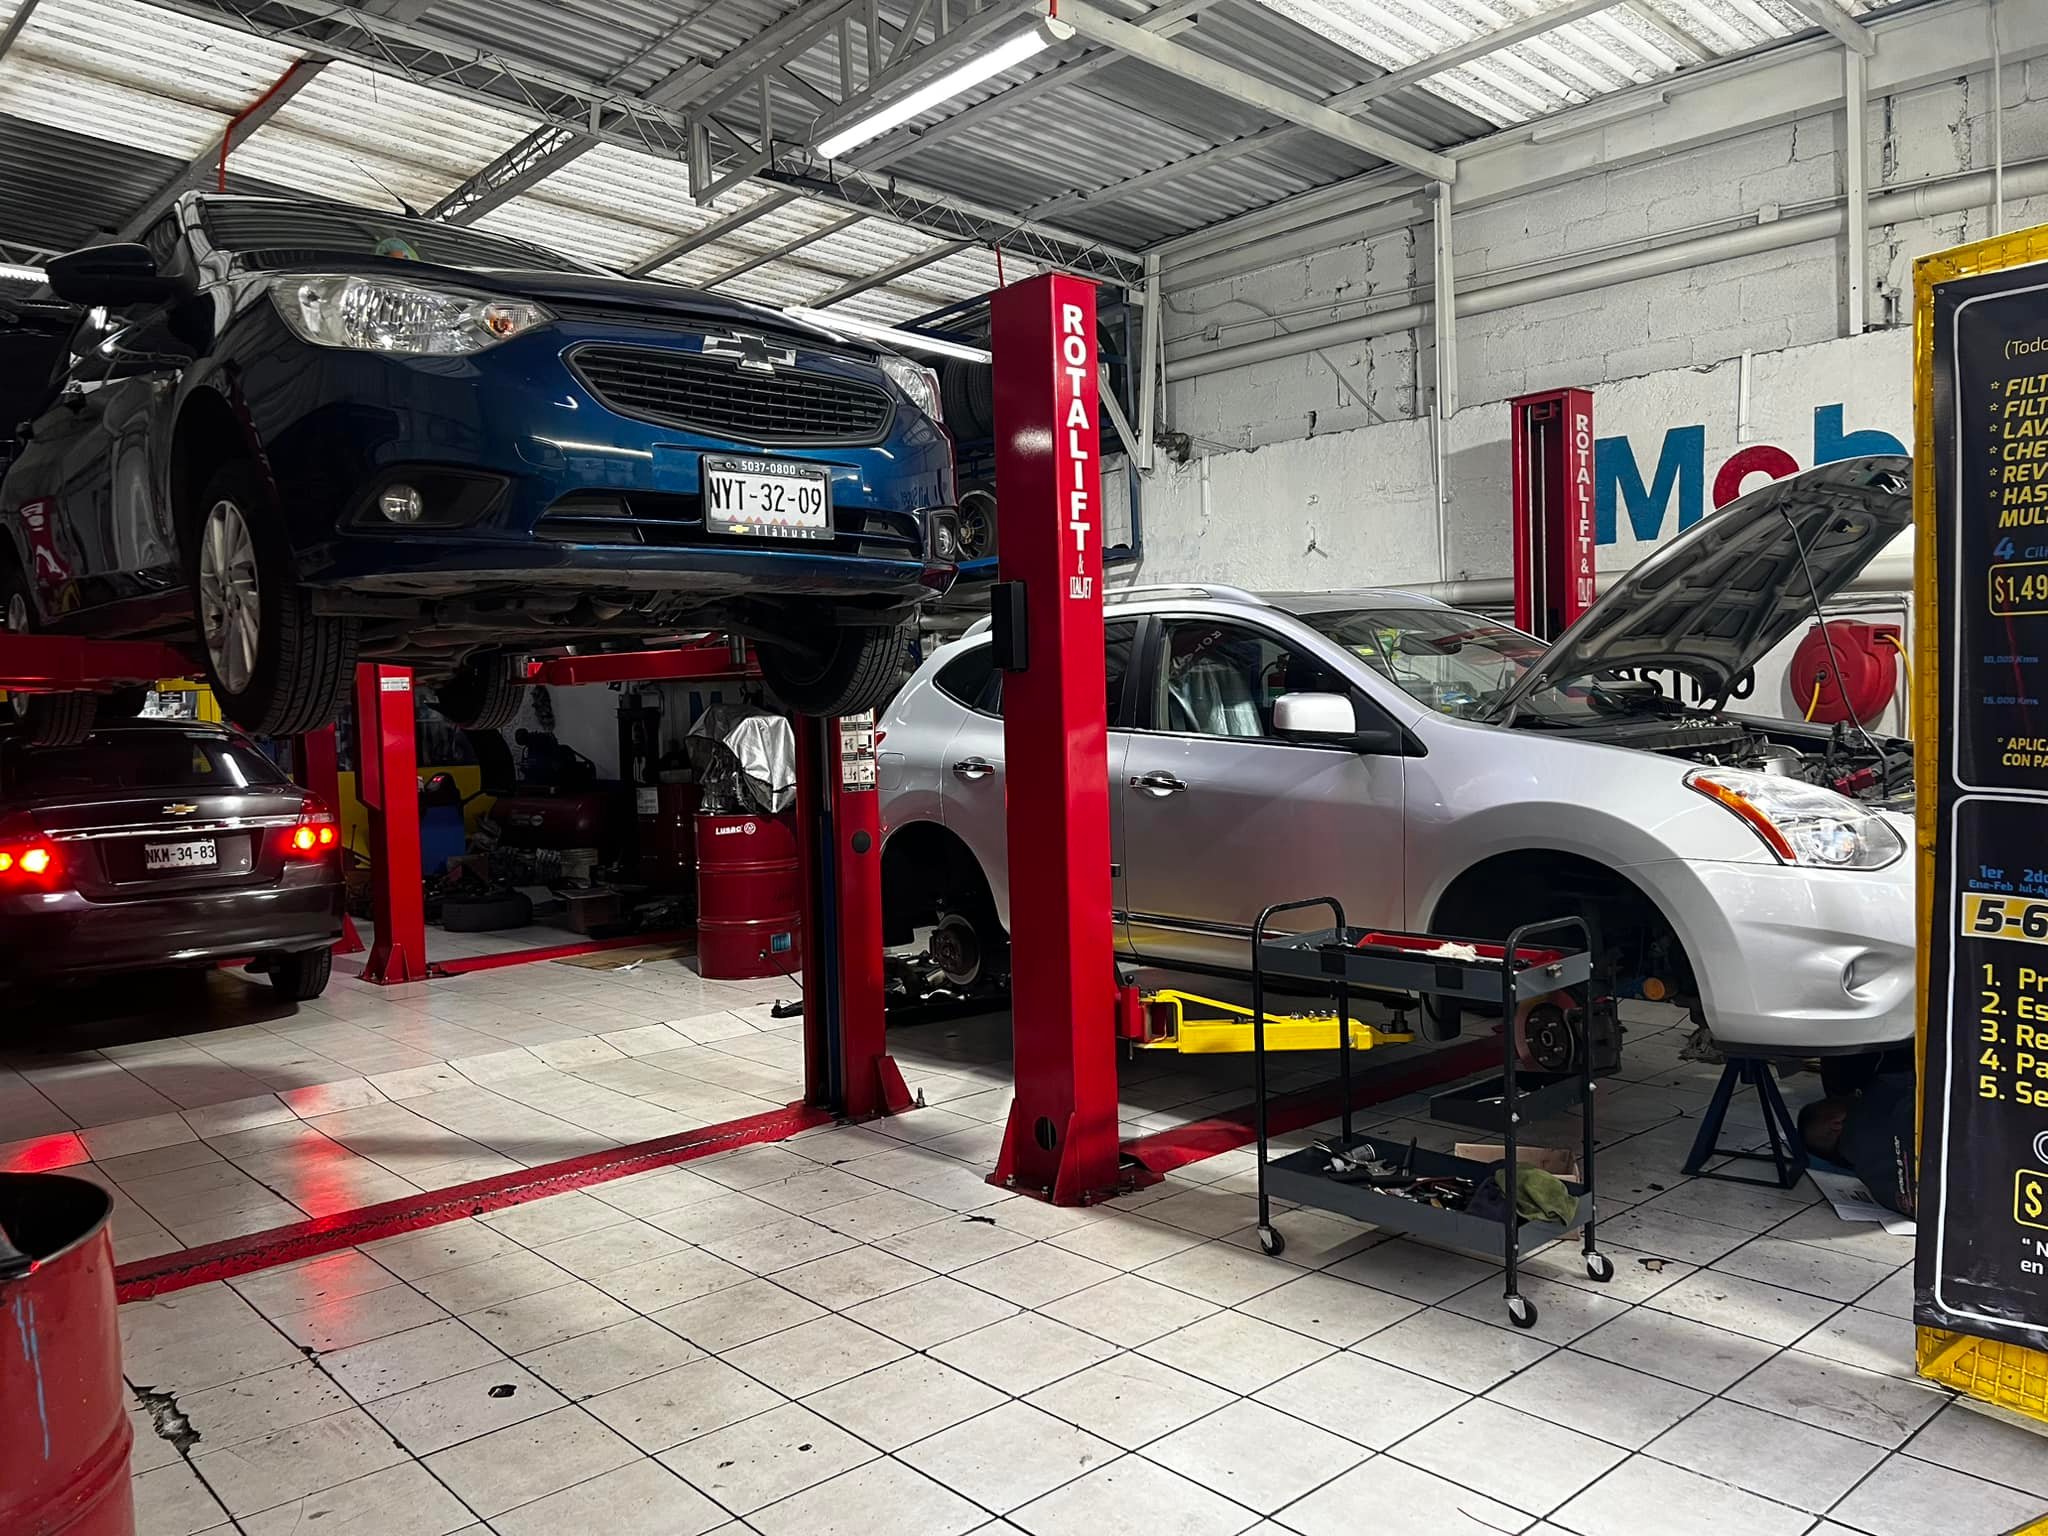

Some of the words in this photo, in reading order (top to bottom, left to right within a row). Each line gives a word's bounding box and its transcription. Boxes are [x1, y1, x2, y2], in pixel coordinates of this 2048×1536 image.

[1063, 303, 1090, 551] ROTALIFT
[1078, 553, 1084, 575] &
[2003, 418, 2048, 439] LAV
[2003, 440, 2048, 461] CHE
[741, 461, 796, 475] 5037-0800
[2003, 462, 2048, 483] REV
[1576, 413, 1591, 554] ROTALIFT
[710, 478, 822, 515] NYT-32-09
[2003, 484, 2048, 505] HAS
[754, 525, 816, 539] Tláhuac
[1993, 537, 2015, 560] 4
[1581, 558, 1589, 573] &
[1995, 574, 2048, 604] $1,49
[2007, 737, 2048, 751] APLIC
[2002, 753, 2031, 767] CON
[1979, 864, 2004, 879] 1er
[1969, 879, 2014, 891] Ene-Feb
[1982, 964, 2001, 986] 1.
[1981, 991, 2007, 1015] 2.
[2017, 996, 2048, 1021] Es
[1980, 1019, 2006, 1043] 3.
[2016, 1024, 2048, 1050] Re
[1979, 1048, 2007, 1072] 4.
[1979, 1075, 2005, 1100] 5.
[2016, 1081, 2048, 1107] Se
[2020, 1260, 2044, 1275] en
